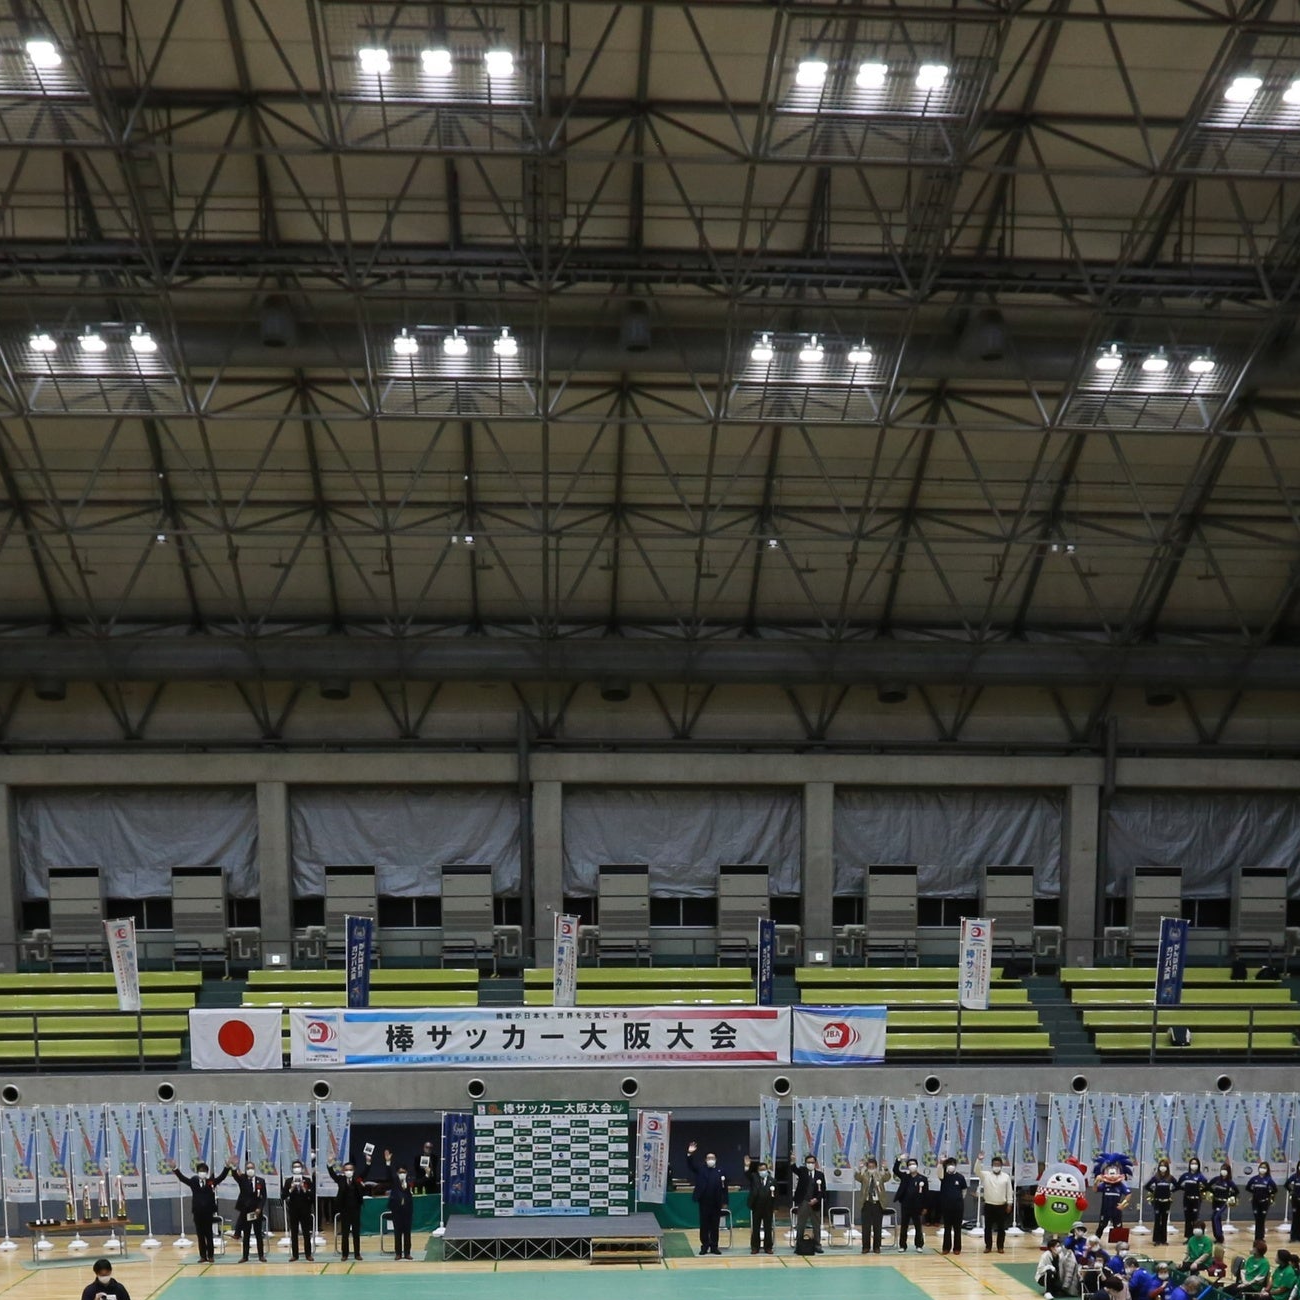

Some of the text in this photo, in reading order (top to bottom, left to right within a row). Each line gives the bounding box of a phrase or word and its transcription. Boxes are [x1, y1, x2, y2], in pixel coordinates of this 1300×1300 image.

[385, 1021, 738, 1053] 棒サッカー大阪大会
[503, 1102, 612, 1114] 棒サッカー大阪大会
